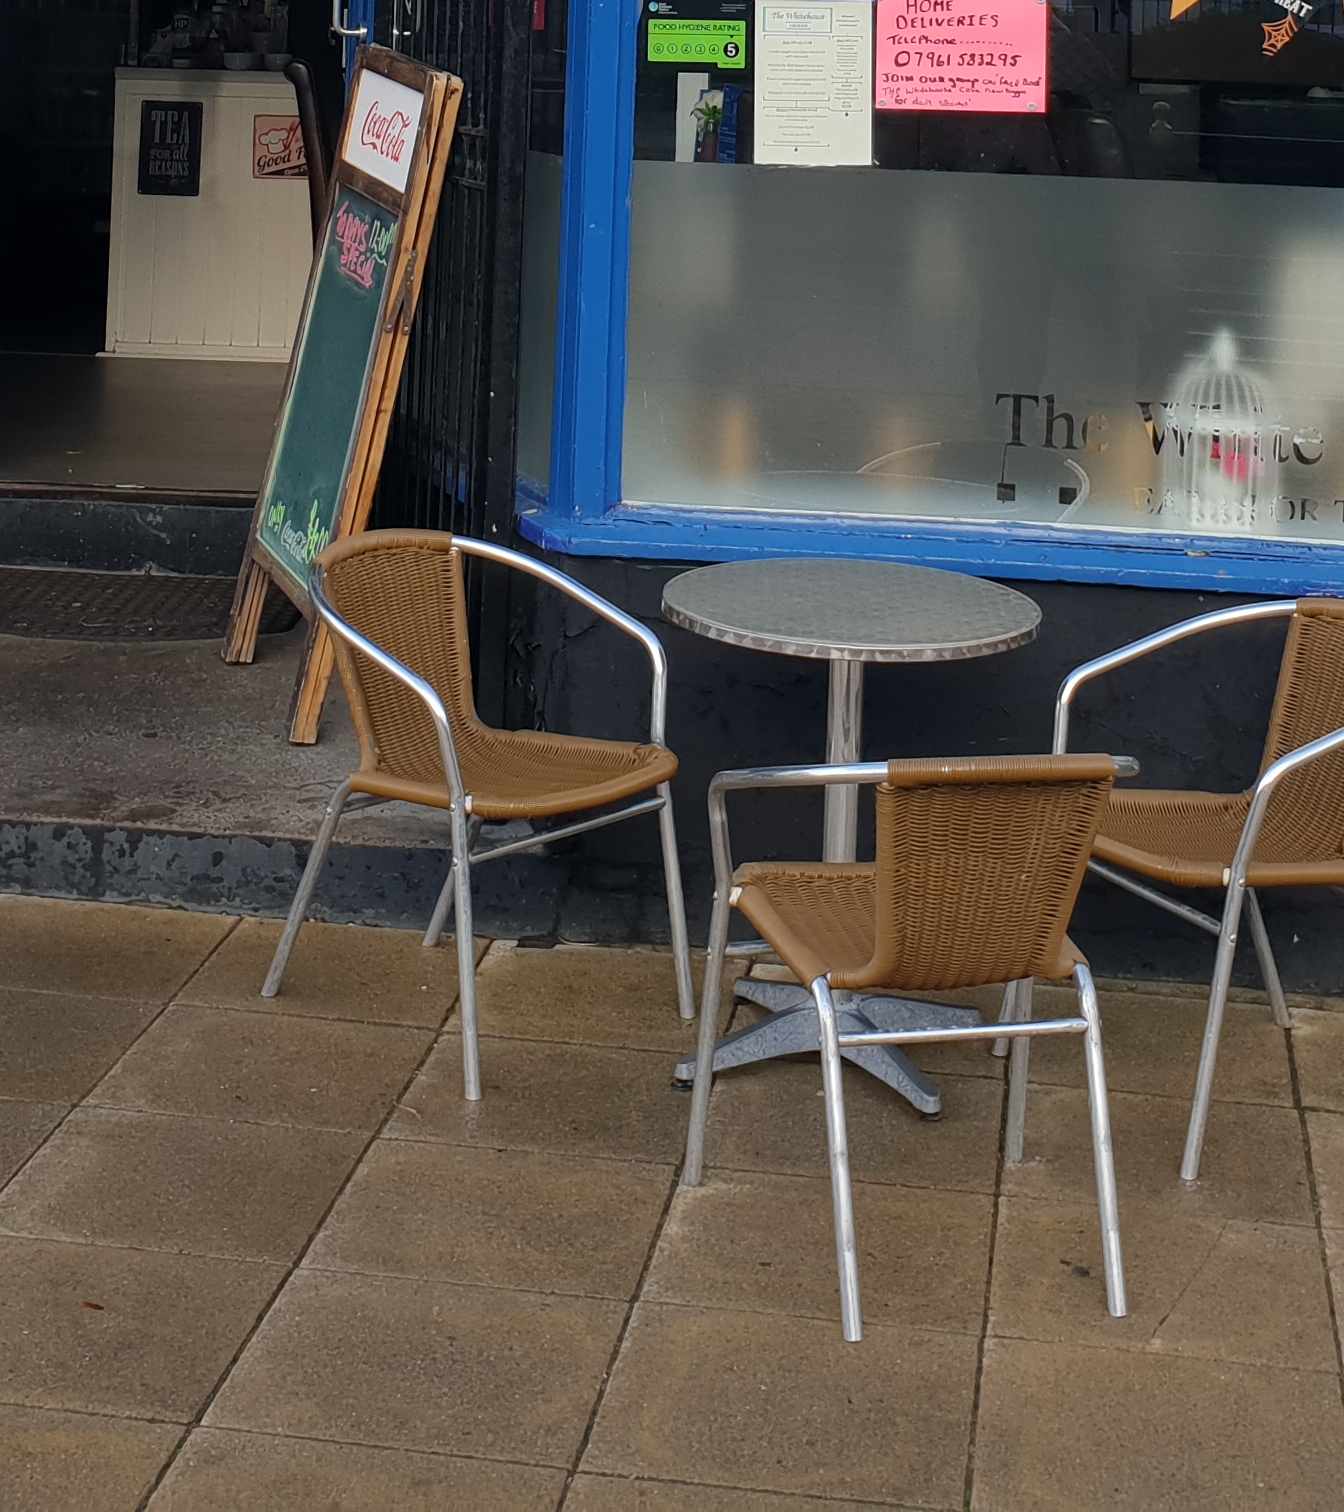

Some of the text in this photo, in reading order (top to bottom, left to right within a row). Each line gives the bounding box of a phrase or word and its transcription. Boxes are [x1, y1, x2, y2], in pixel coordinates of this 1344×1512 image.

[653, 23, 677, 31] FOOD
[713, 24, 741, 32] RATING
[895, 14, 1000, 29] DELIVERIES
[894, 50, 1023, 68] 07961 583295
[881, 72, 914, 84] JOIN
[151, 110, 190, 144] TEA
[172, 143, 189, 161] all
[256, 150, 292, 173] Good
[995, 393, 1109, 453] The
